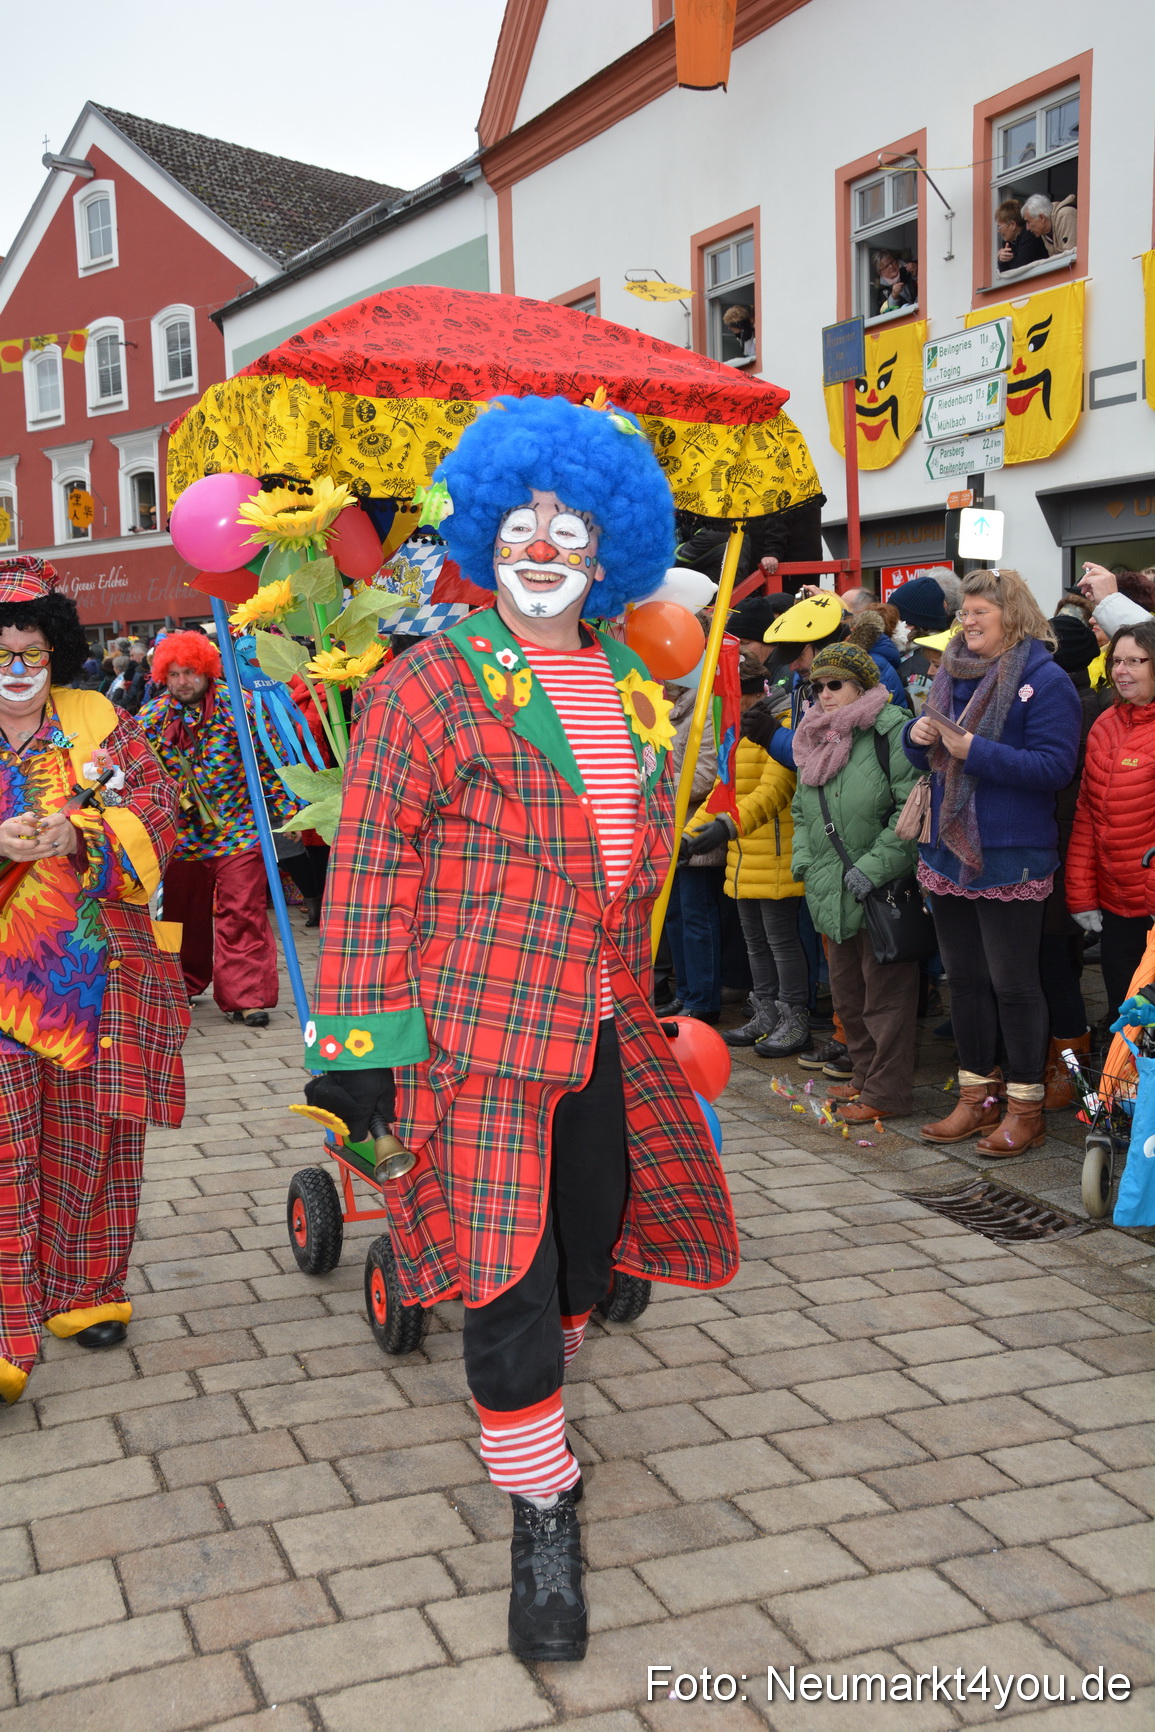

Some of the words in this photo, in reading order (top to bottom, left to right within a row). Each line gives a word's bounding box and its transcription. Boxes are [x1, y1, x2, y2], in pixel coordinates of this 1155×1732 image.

[939, 340, 972, 357] Beilngries
[940, 366, 960, 379] Töging
[938, 393, 973, 410] Riedenburg
[937, 415, 967, 432] Mühlbach
[940, 446, 965, 459] Parsberg
[994, 439, 1001, 447] km
[940, 460, 975, 475] Breitenbrunn
[993, 456, 1001, 464] km
[98, 565, 129, 590] Erlebnis
